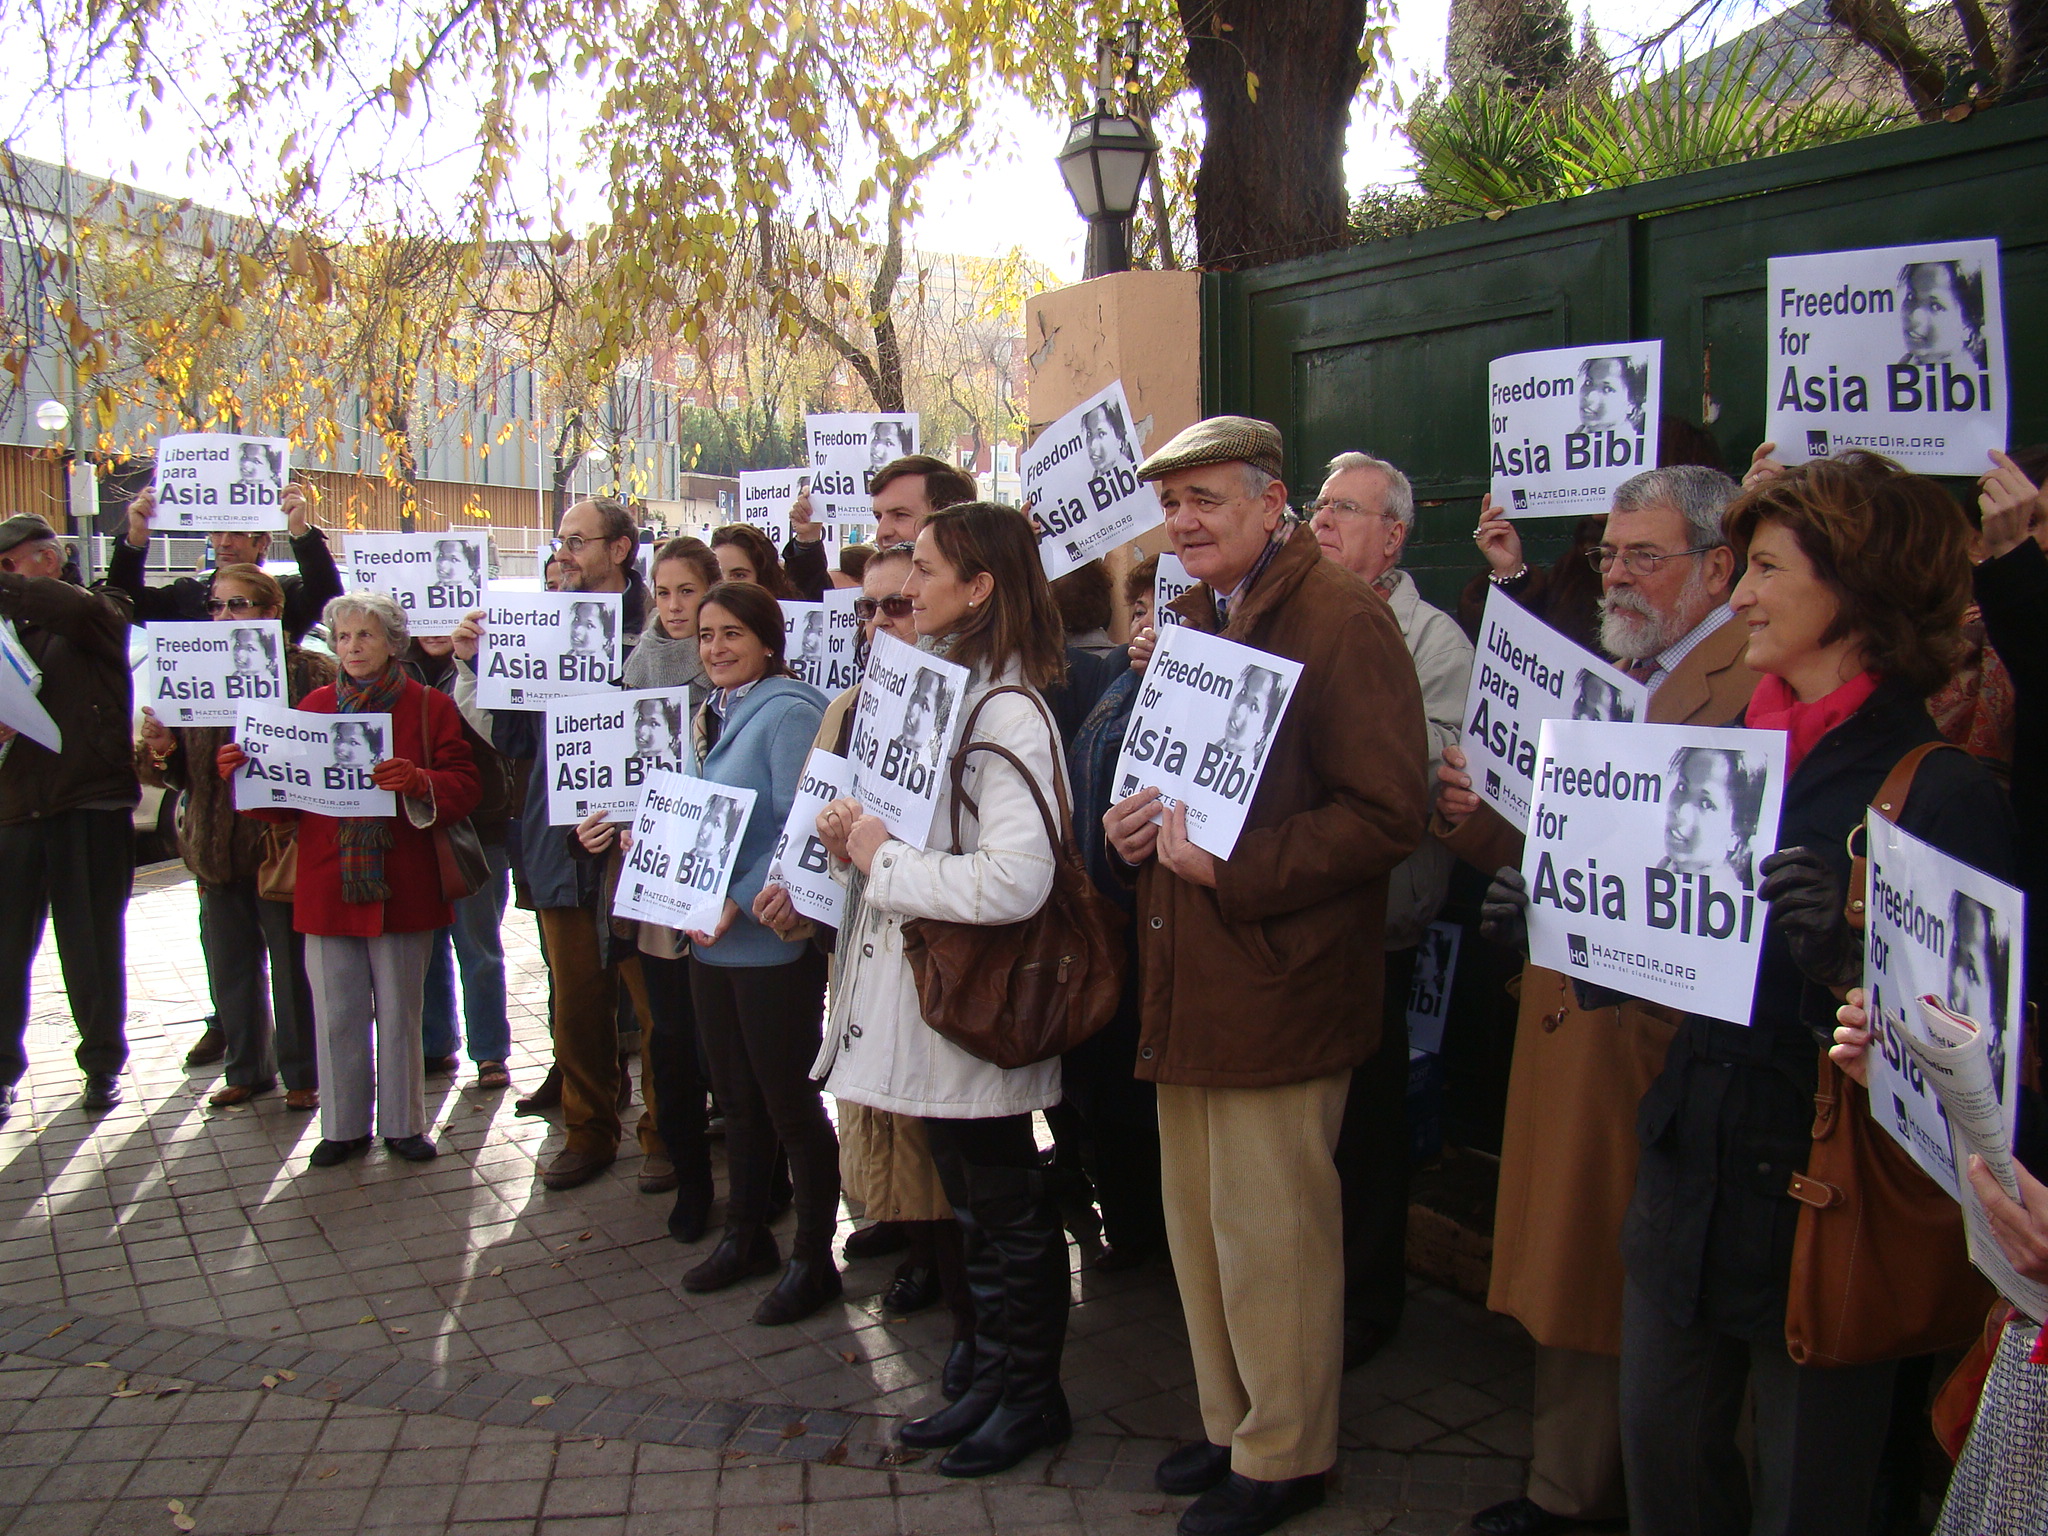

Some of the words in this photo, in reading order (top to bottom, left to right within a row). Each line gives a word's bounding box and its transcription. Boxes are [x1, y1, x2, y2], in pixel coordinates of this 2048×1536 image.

[1780, 284, 1894, 317] Freedom
[1779, 327, 1810, 355] for
[1492, 377, 1574, 406] Freedom
[1777, 365, 1868, 413] Asia
[1887, 363, 1991, 412] Bibi
[1492, 413, 1508, 435] for
[814, 431, 867, 446] Freedom
[165, 448, 230, 462] Libertad
[815, 451, 827, 466] for
[1027, 434, 1083, 486] Freedom
[1491, 439, 1551, 477] Asia
[1565, 430, 1645, 470] Bibi
[163, 467, 197, 482] para
[811, 471, 855, 495] Asia
[159, 483, 218, 505] Asia
[230, 483, 283, 505] Bibi
[746, 484, 790, 501] Libertad
[746, 506, 768, 521] para
[1032, 498, 1087, 545] Asia
[354, 549, 432, 564] Freedom
[356, 569, 377, 583] for
[427, 585, 481, 608] Bibi
[488, 608, 560, 626] Libertad
[830, 610, 859, 629] Free
[156, 638, 229, 652] Freedom
[490, 632, 525, 649] para
[829, 634, 845, 653] for
[157, 657, 178, 671] for
[488, 652, 548, 680] Asia
[559, 654, 614, 683] Bibi
[1487, 621, 1564, 699] Libertad
[158, 676, 215, 700] Asia
[225, 675, 280, 698] Bibi
[868, 655, 908, 697] Libertad
[1153, 650, 1234, 700] Freedom
[1479, 663, 1519, 710] para
[860, 690, 879, 717] para
[1140, 682, 1163, 710] for
[245, 716, 328, 743] Freedom
[556, 710, 624, 734] Libertad
[243, 737, 269, 754] for
[556, 740, 591, 761] para
[1468, 697, 1537, 780] Asia
[852, 718, 879, 769] Asia
[880, 738, 936, 800] Bibi
[1123, 716, 1188, 776] Asia
[1193, 742, 1255, 805] Bibi
[245, 757, 311, 787] Asia
[324, 767, 376, 790] Bib
[556, 760, 612, 791] Asia
[1541, 757, 1662, 803] Freedom
[645, 789, 702, 821] Freedom
[639, 814, 656, 834] for
[1536, 803, 1568, 841] for
[629, 839, 671, 878] Asia
[675, 852, 724, 894] Bibi
[1532, 851, 1626, 921] Asia
[1645, 867, 1754, 944] Bibi
[1873, 862, 1945, 958] Freedom
[1870, 921, 1889, 975] for
[1408, 983, 1441, 1017] ibi
